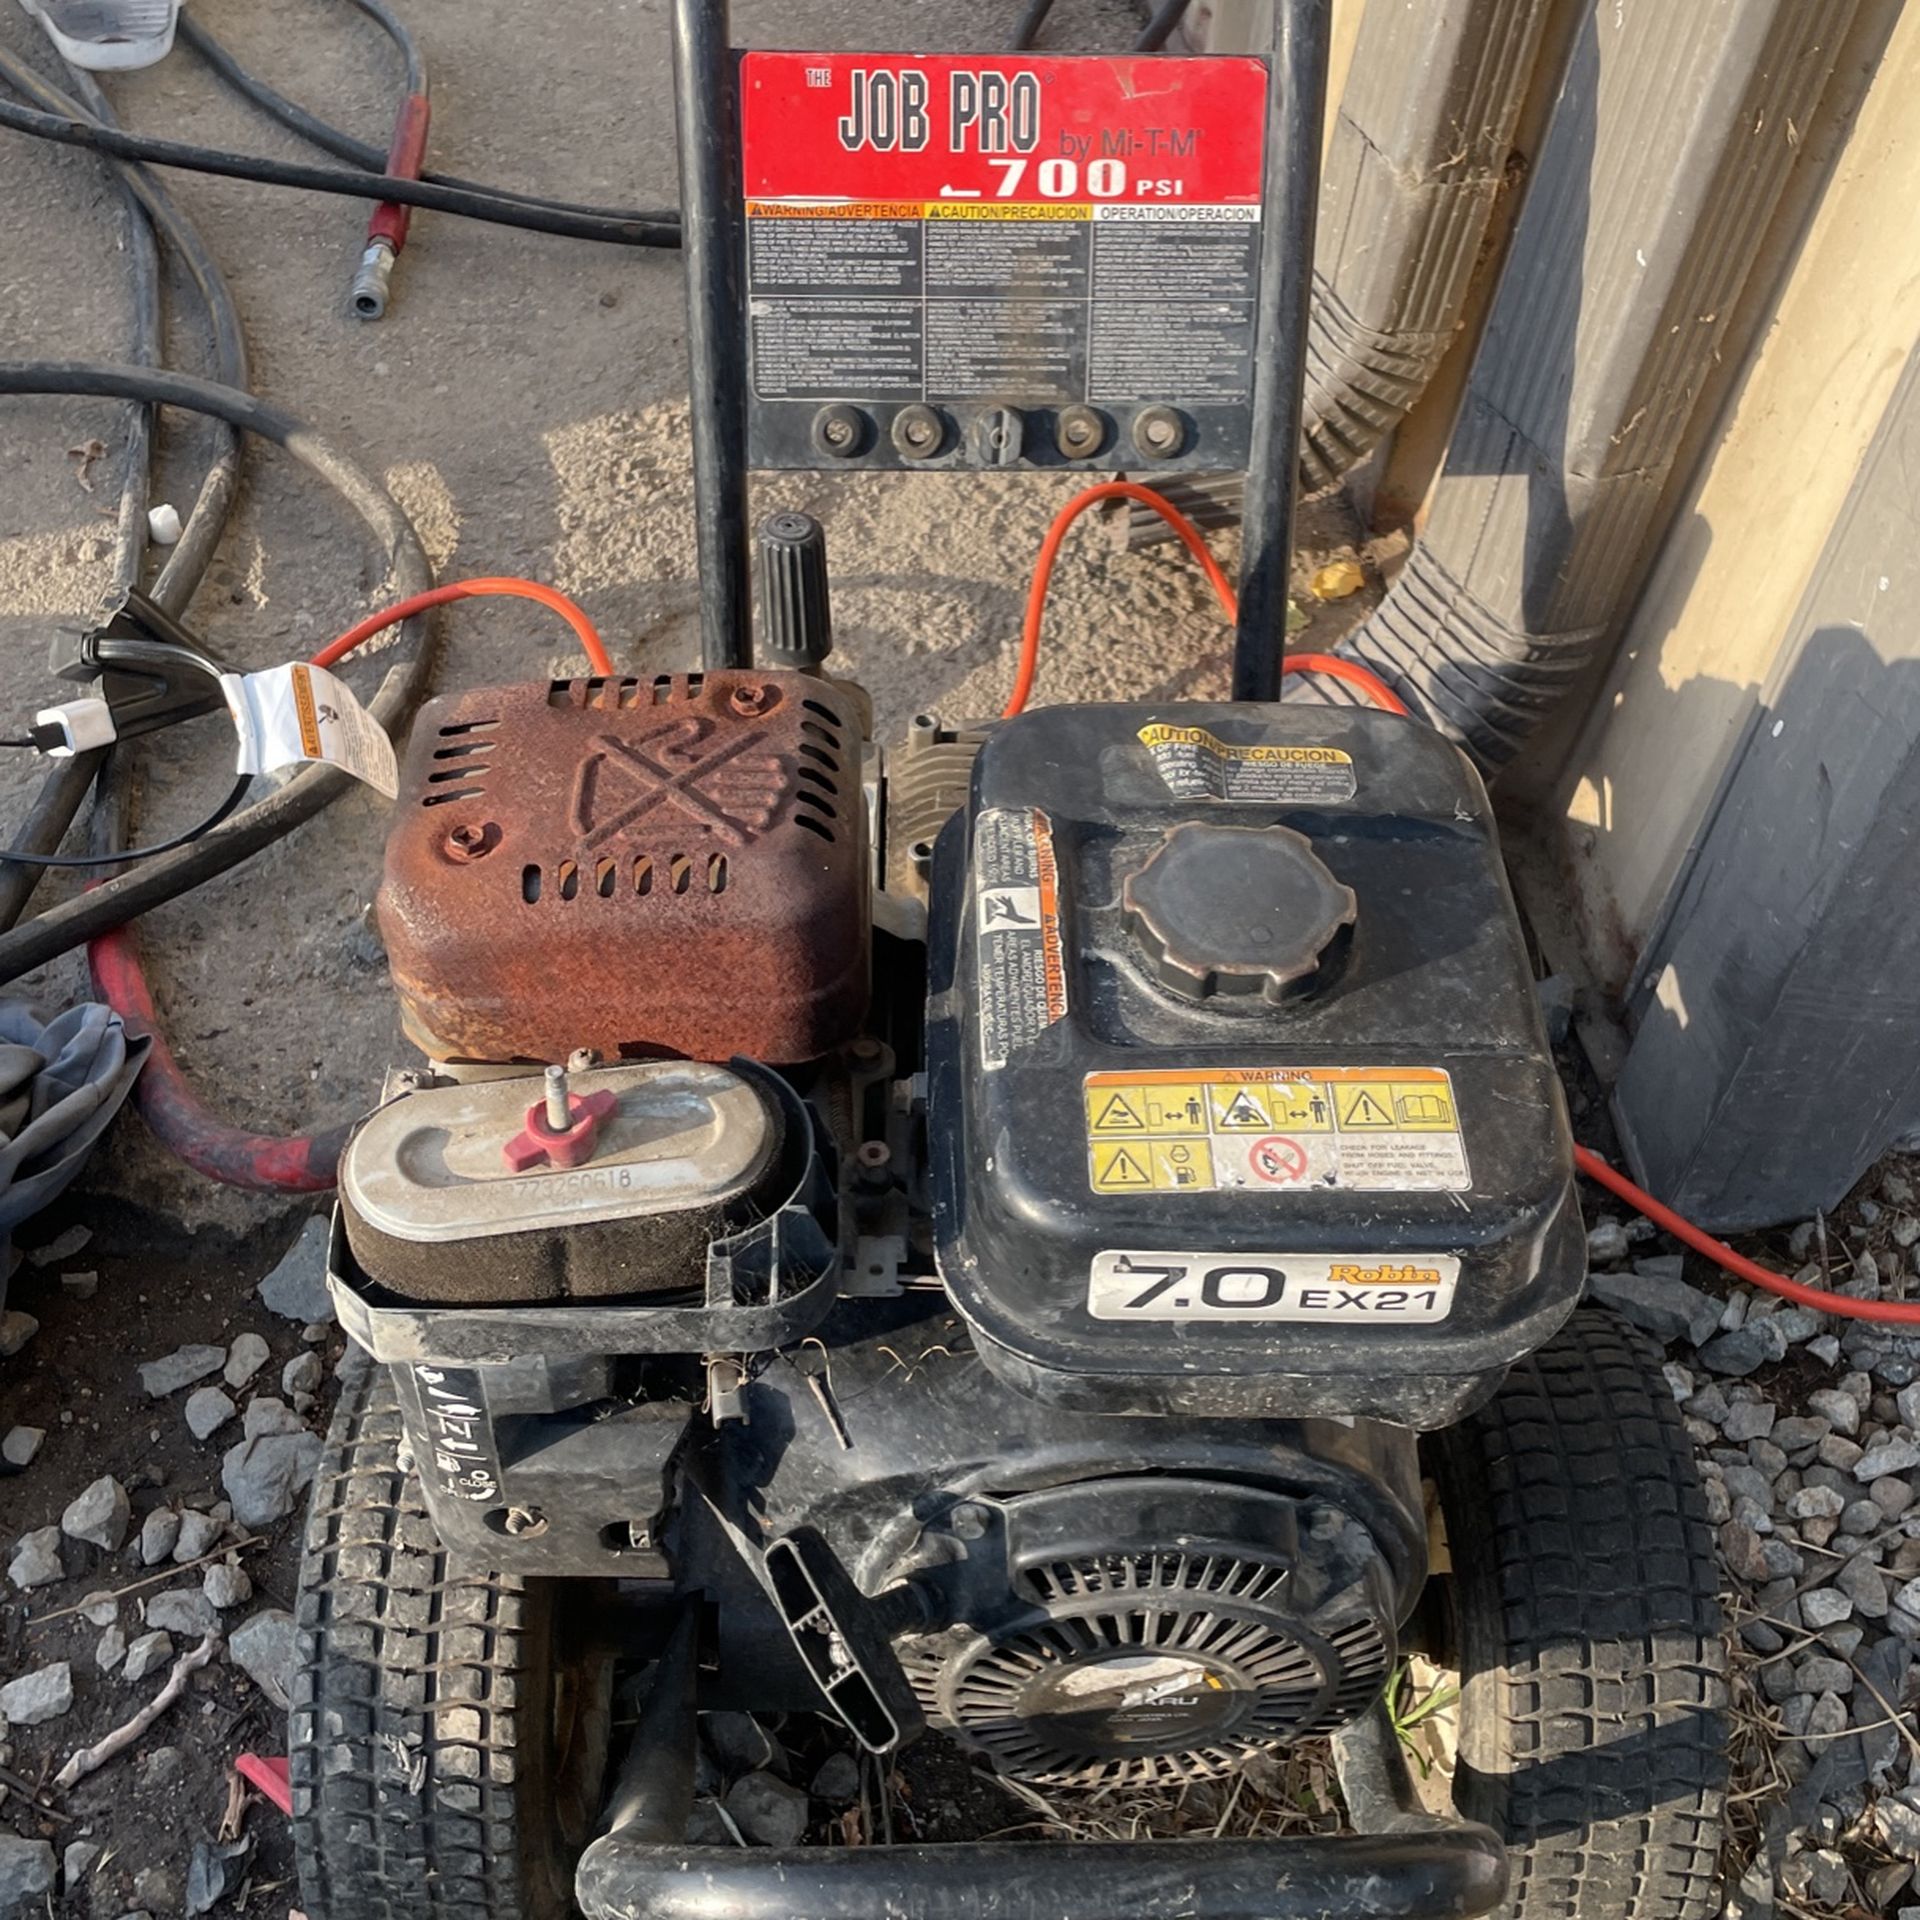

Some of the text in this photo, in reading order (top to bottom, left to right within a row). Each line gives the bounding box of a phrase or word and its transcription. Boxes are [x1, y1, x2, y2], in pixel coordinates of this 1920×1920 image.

[806, 69, 1040, 153] THE JOB PRO
[1059, 129, 1092, 163] by
[1136, 180, 1183, 196] PSI
[763, 204, 920, 217] WARNING/ADVERTENCIA
[941, 205, 1087, 219] CAUTION/PRECAUCION
[1100, 207, 1255, 220] OPERATION/OPERACION
[1033, 949, 1045, 984] RIESGO
[1036, 986, 1046, 999] DE
[1240, 1070, 1312, 1081] WARNING
[1327, 1264, 1442, 1286] Robin
[1113, 1265, 1436, 1311] 7.0 EX21
